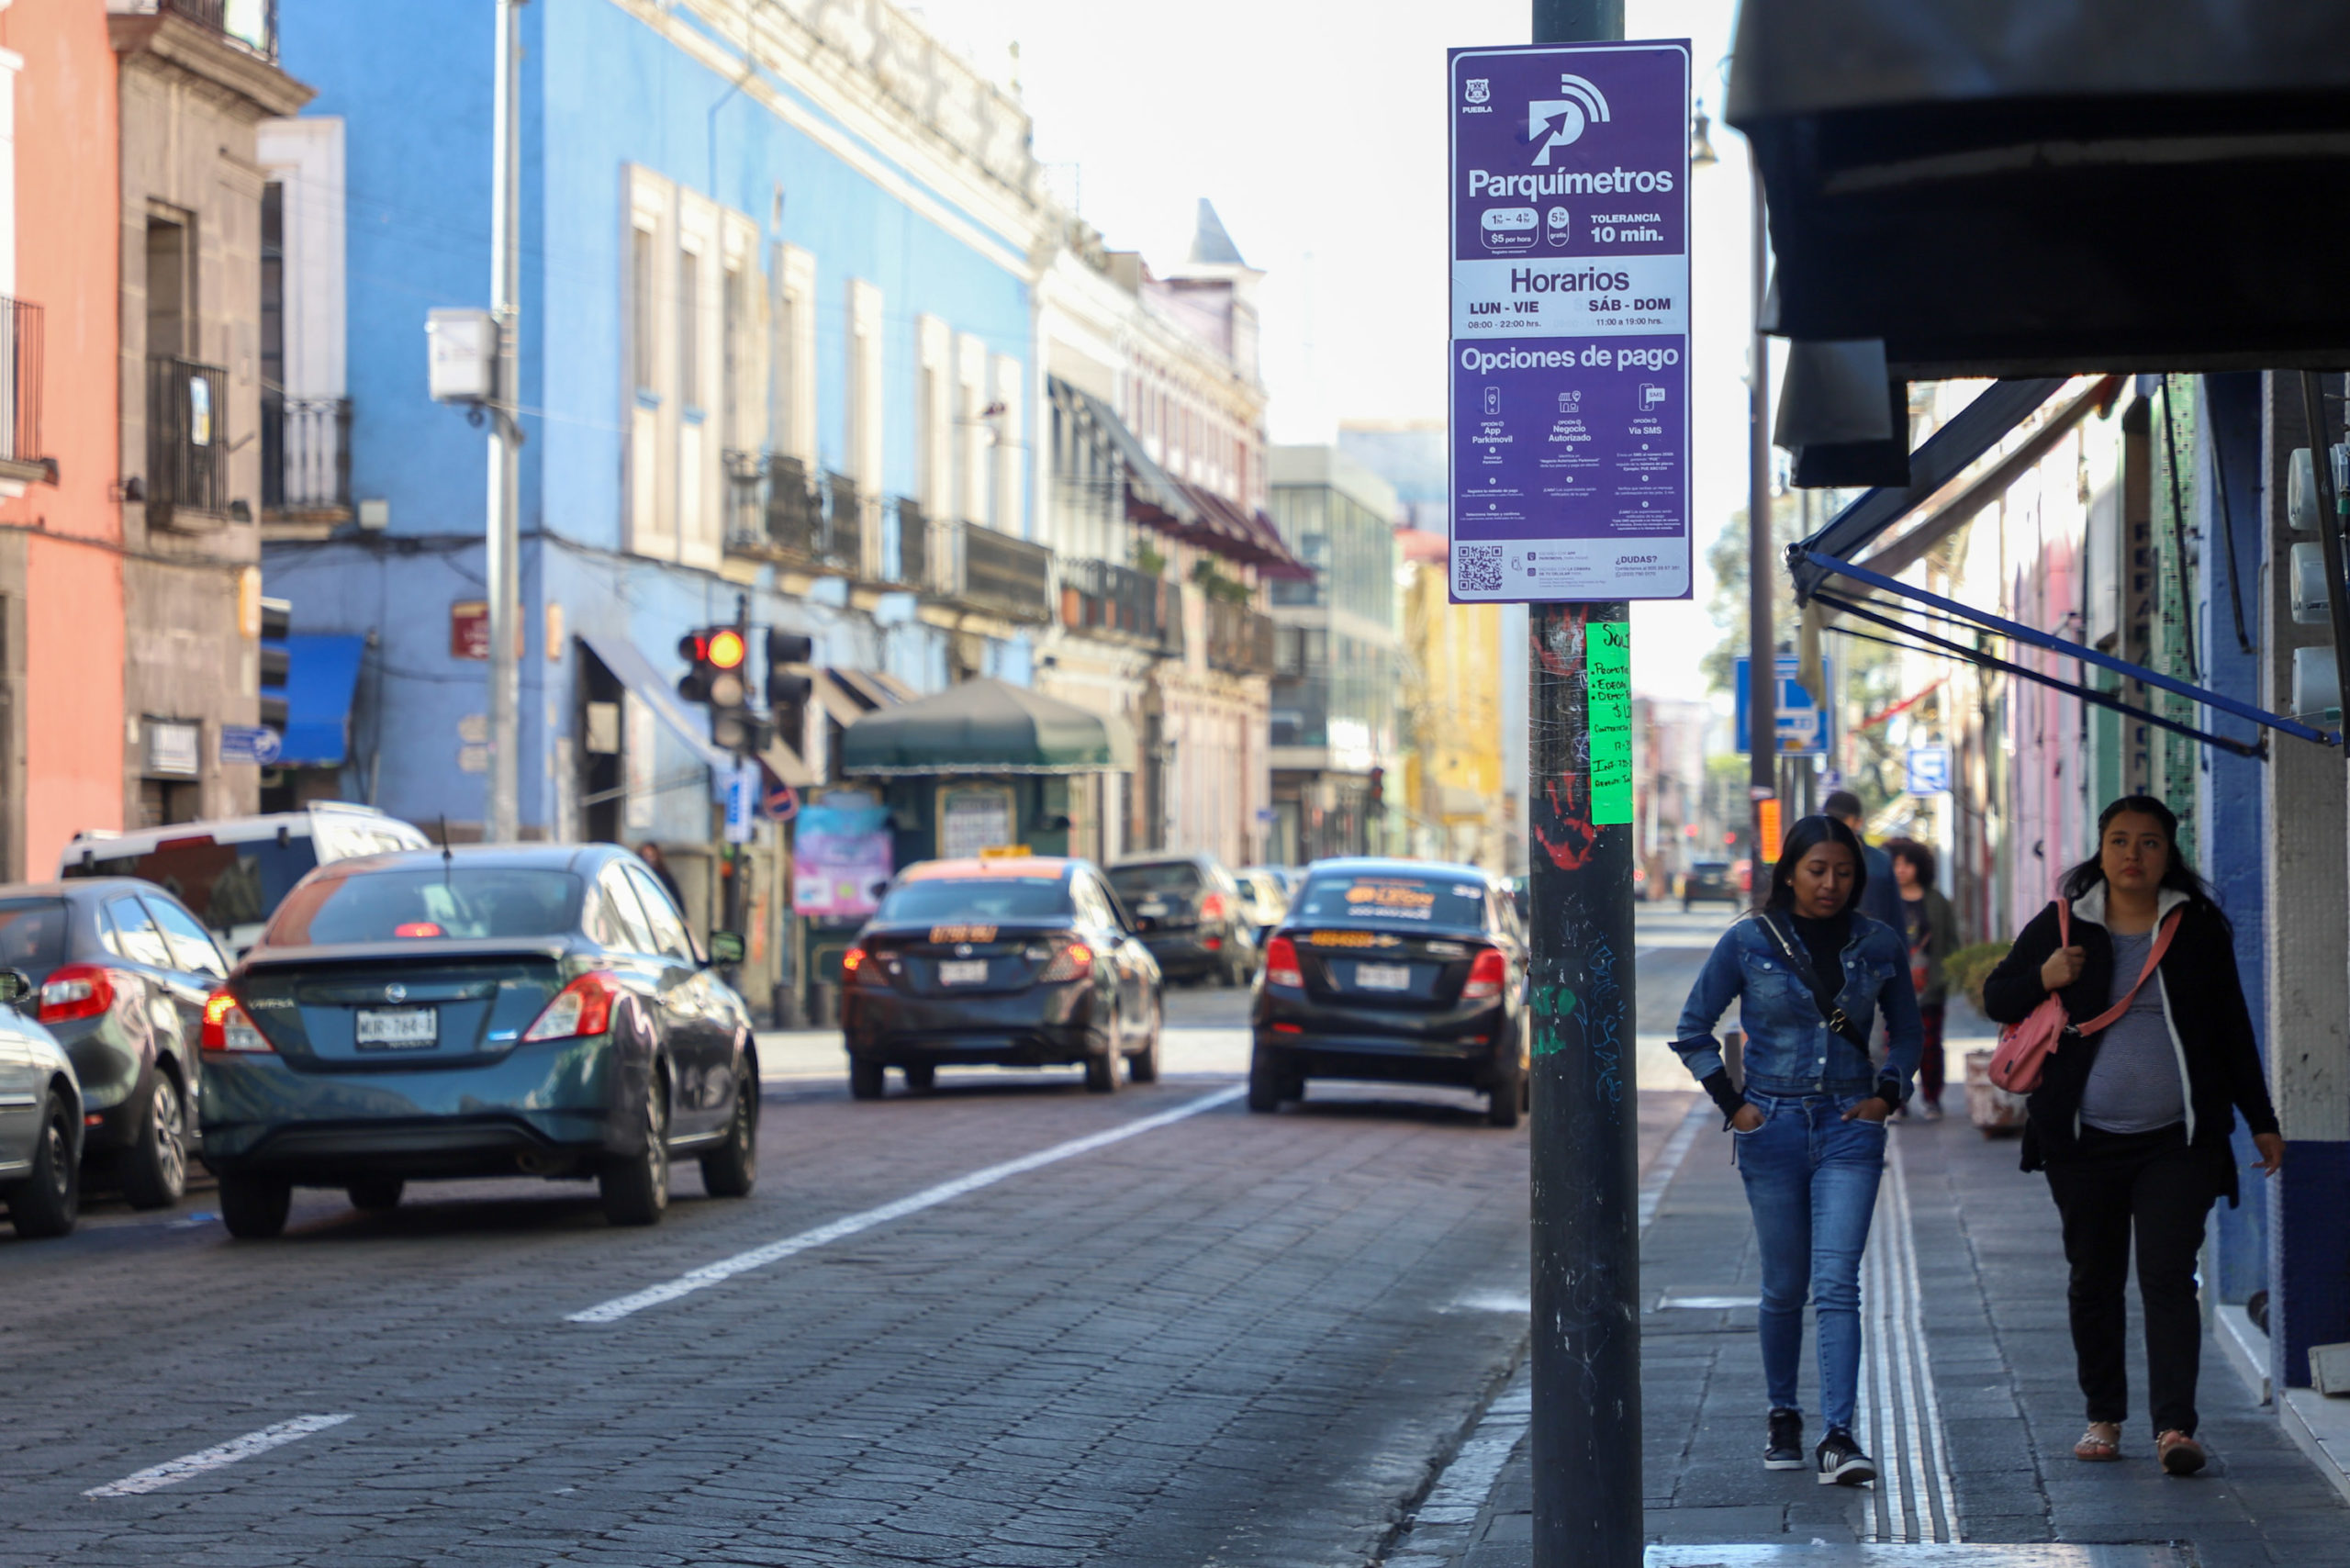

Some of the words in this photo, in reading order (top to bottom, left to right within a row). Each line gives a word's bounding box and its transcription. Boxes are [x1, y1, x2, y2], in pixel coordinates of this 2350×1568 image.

[1469, 166, 1673, 203] Parquímetros
[1591, 213, 1662, 224] TOLERANCIA
[1491, 232, 1505, 244] $5
[1550, 231, 1567, 240] gratis
[1591, 227, 1616, 243] 10
[1620, 226, 1664, 242] min.
[1511, 266, 1630, 293] Horarios
[1470, 302, 1502, 315] LUN
[1514, 301, 1539, 314] VIE
[1588, 296, 1622, 312] SÁB
[1633, 298, 1672, 311] DOM
[1526, 319, 1542, 328] hrs.
[1596, 318, 1617, 327] 11:00
[1626, 318, 1647, 326] 19:00
[1648, 317, 1664, 325] hrs.
[1460, 346, 1575, 375] Opciones
[1580, 344, 1612, 367] de
[1617, 347, 1679, 372] pago
[1484, 427, 1502, 436] App
[1552, 424, 1586, 434] Negocio
[1643, 426, 1662, 434] SMS
[1472, 435, 1514, 444] Parkimovil
[1548, 433, 1592, 442] Autorizado
[1615, 554, 1658, 566] ¿DUDAS?
